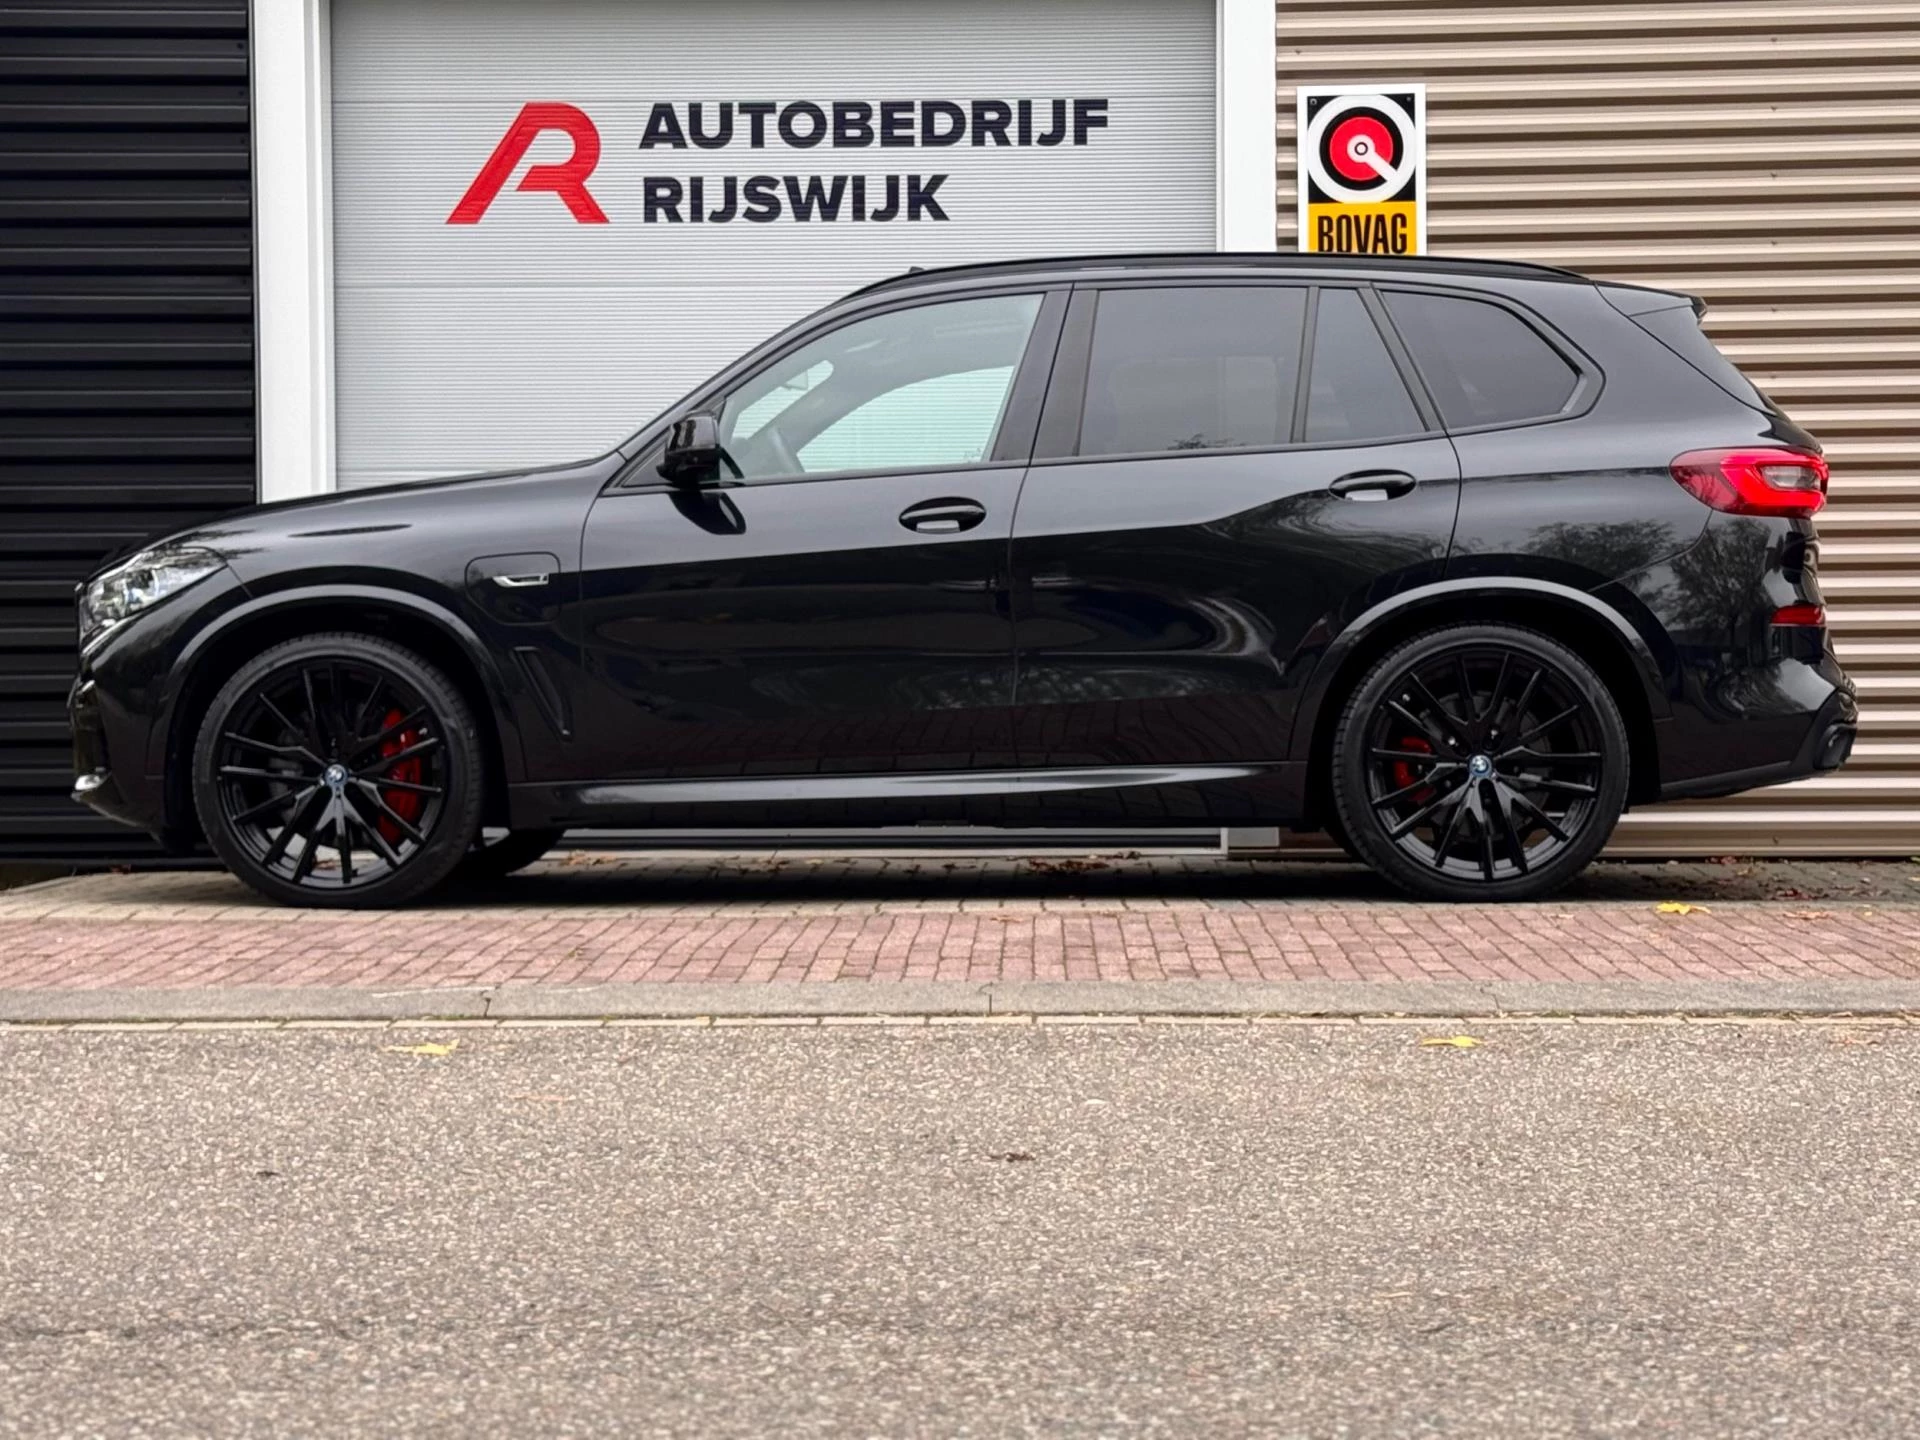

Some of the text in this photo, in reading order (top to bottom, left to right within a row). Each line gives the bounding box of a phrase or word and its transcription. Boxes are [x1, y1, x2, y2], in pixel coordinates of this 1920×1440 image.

[639, 98, 1109, 150] AUTOBEDRIJF
[643, 174, 949, 223] RIJSWIJK
[1317, 212, 1408, 254] BOVAG
